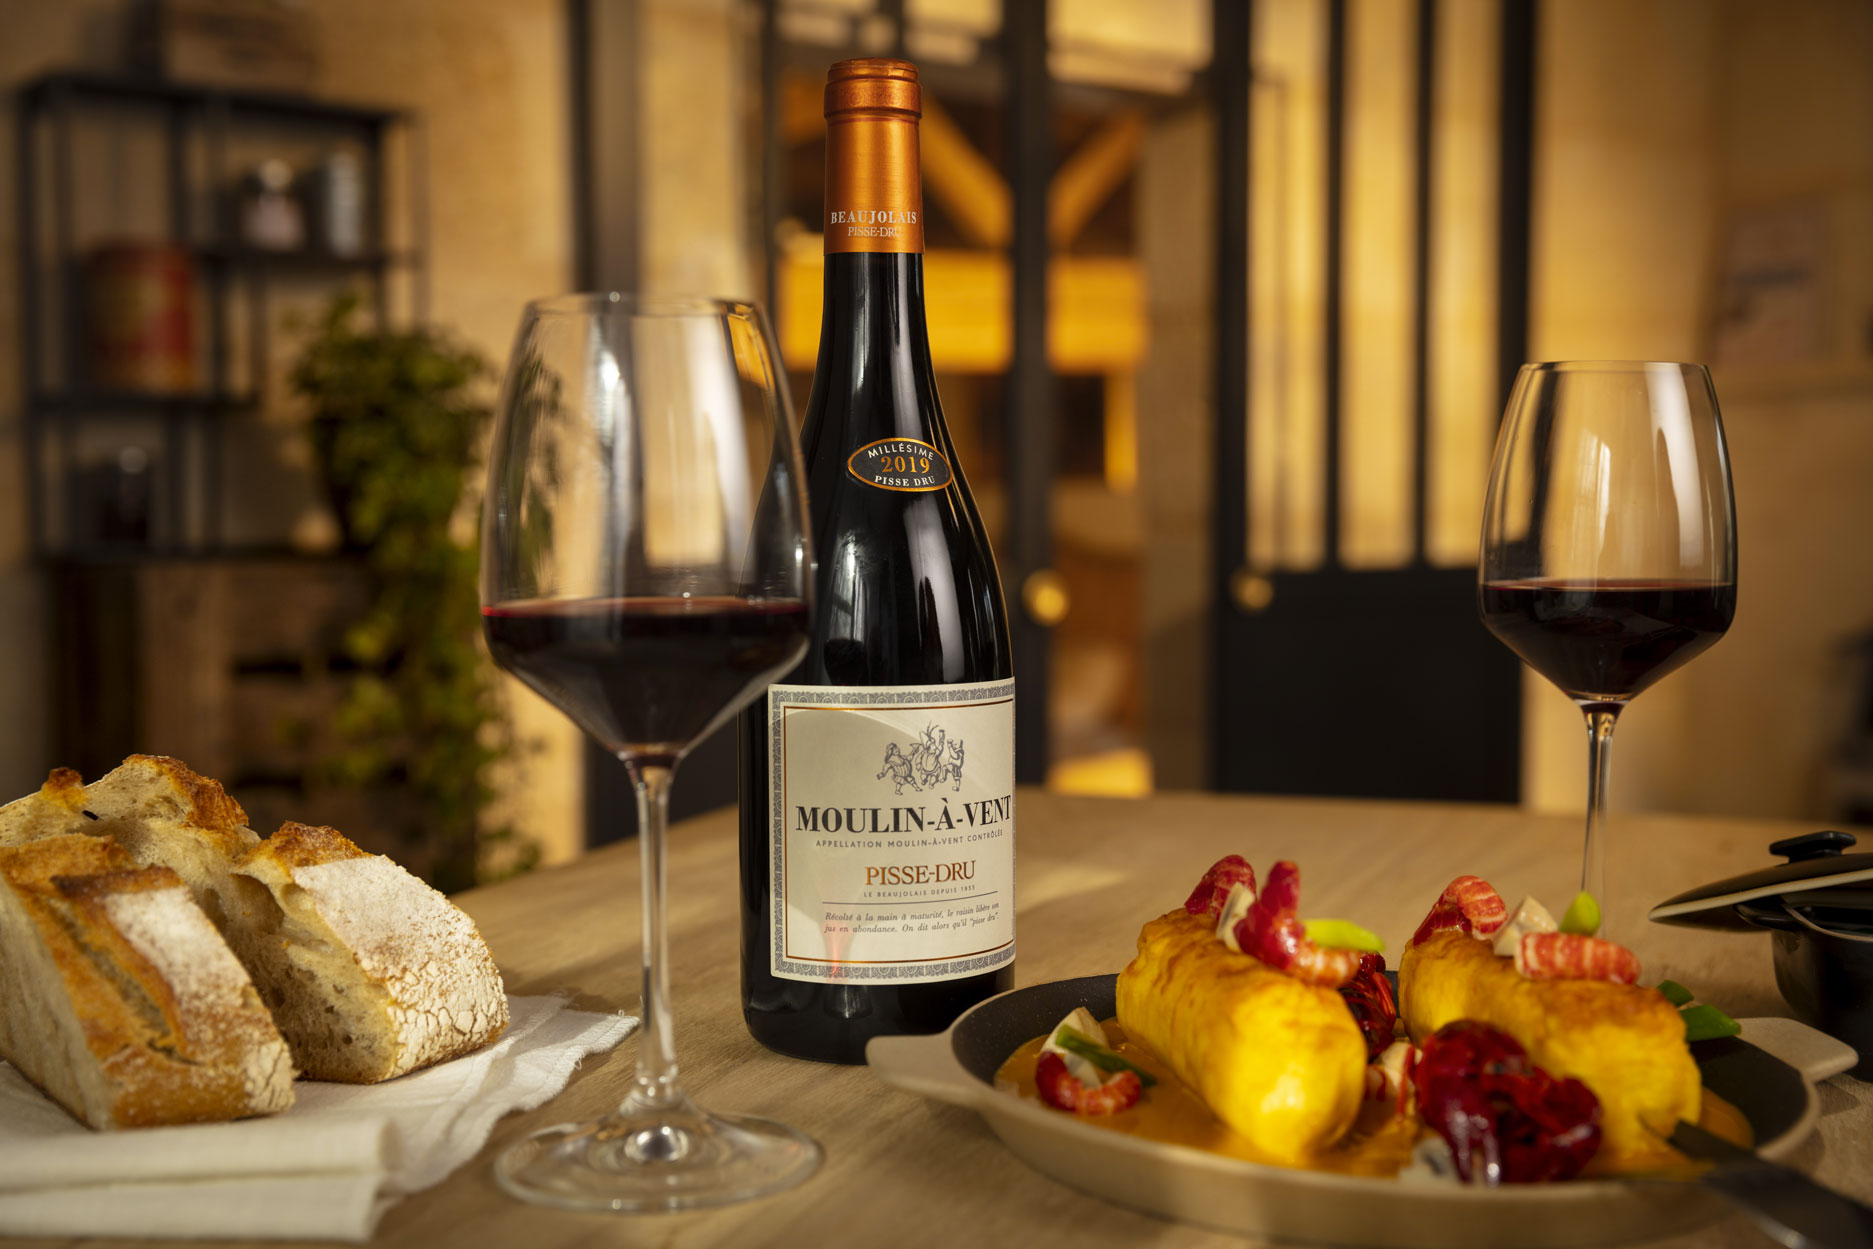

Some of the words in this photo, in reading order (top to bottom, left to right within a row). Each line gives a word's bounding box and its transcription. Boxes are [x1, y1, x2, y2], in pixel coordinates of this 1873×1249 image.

[831, 210, 917, 224] BEAUJOLAIS
[848, 226, 902, 237] PISSE-DRU
[880, 455, 930, 474] 2019
[874, 475, 910, 487] PISSE
[913, 475, 936, 487] DRU
[795, 794, 1011, 834] MOULIN-À-VENT
[816, 840, 882, 848] APPELLATION
[888, 836, 963, 848] MOULIN-À-VENT
[967, 828, 1003, 842] CONTRÔLÉE
[864, 860, 976, 886] PISSE-DRU
[877, 890, 927, 898] BEAUJOLAIS
[931, 887, 957, 895] DEPUIS
[825, 912, 853, 921] Récolté
[865, 912, 873, 921] la
[877, 912, 898, 921] main
[956, 906, 974, 916] raisin
[824, 923, 836, 933] jus
[902, 923, 914, 932] On
[917, 923, 928, 931] dit
[932, 921, 949, 930] alors
